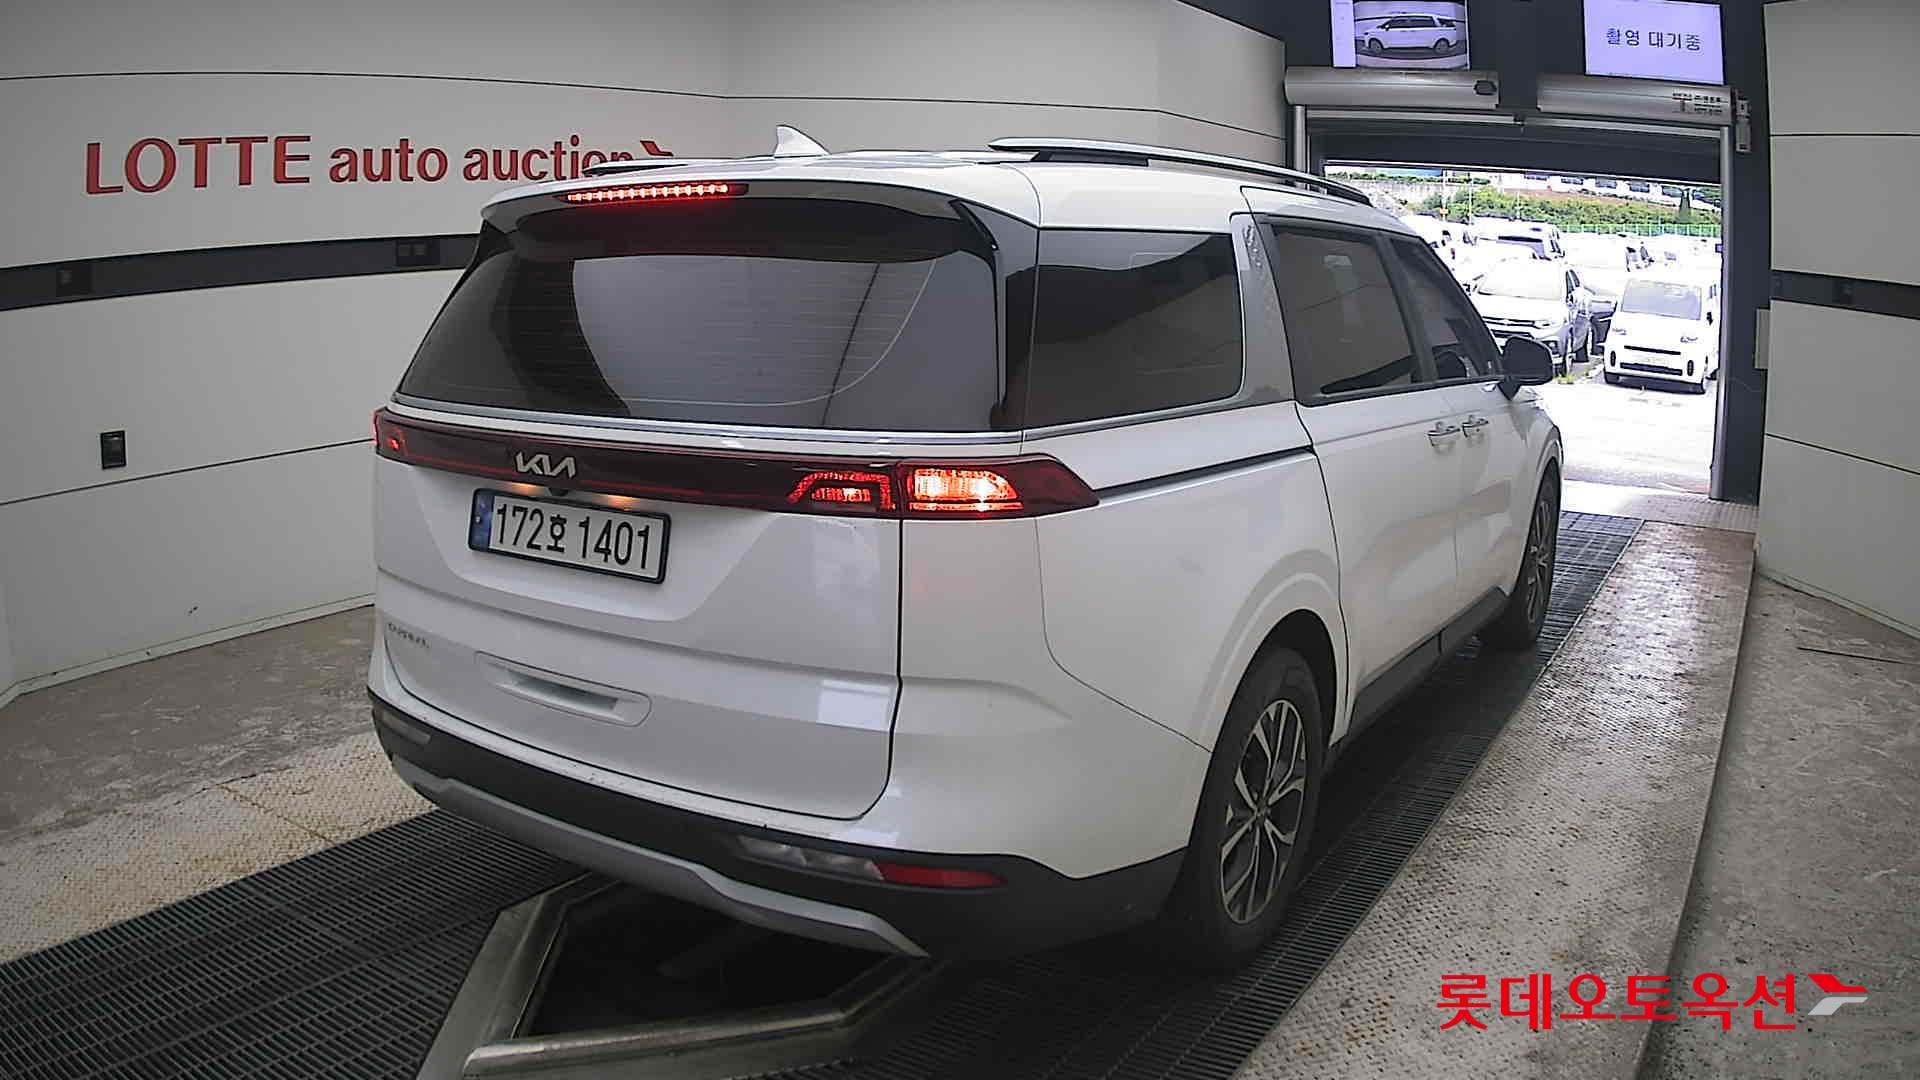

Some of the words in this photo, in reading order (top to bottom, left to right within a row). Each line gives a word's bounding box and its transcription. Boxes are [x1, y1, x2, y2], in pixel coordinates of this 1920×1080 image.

[1606, 27, 1640, 46] 촬영
[1648, 31, 1701, 51] 대기중
[86, 136, 311, 194] LOTTE
[329, 138, 448, 183] auto
[515, 451, 576, 478] KIA
[497, 504, 567, 552] 172호
[578, 516, 650, 569] 1401
